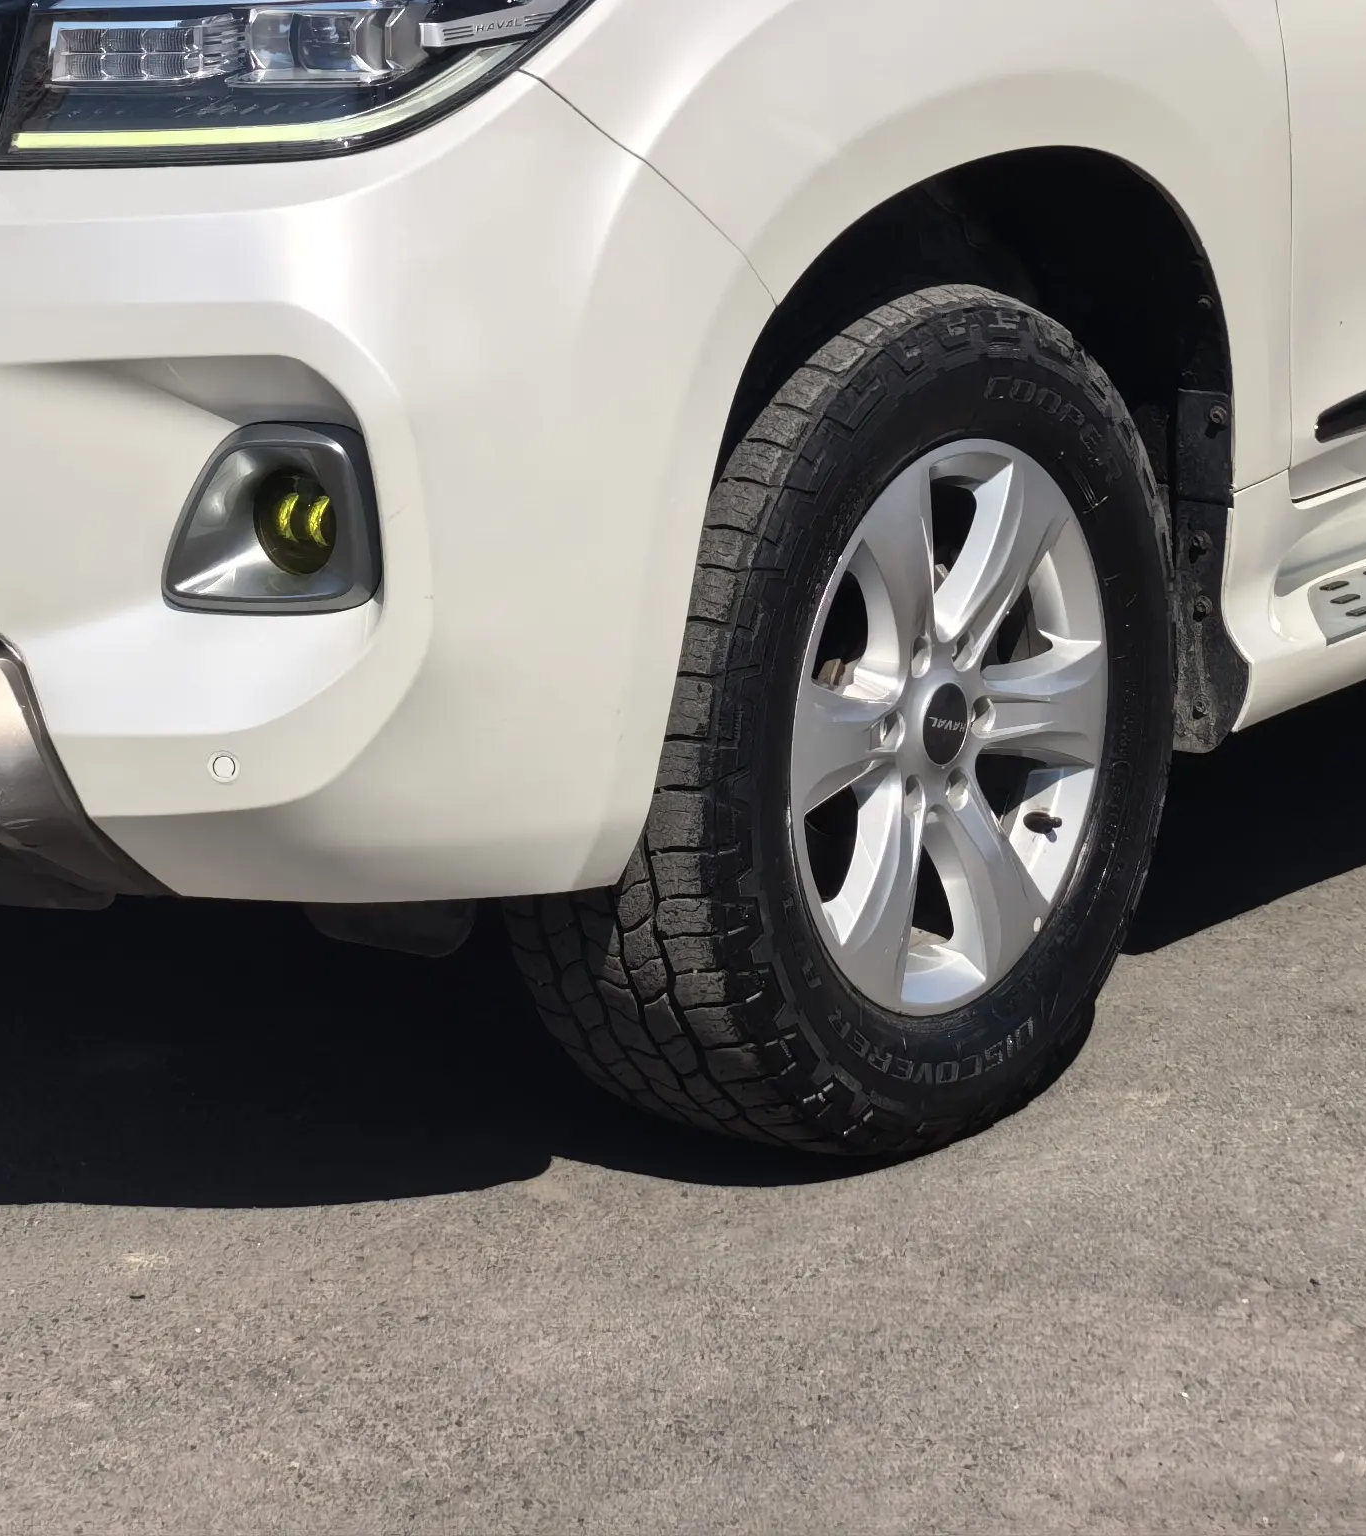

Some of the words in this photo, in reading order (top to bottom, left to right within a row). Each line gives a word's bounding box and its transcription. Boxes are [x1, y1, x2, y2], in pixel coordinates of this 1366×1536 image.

[475, 17, 523, 32] HAVAL
[983, 375, 1124, 488] COOPER
[928, 716, 967, 733] HAVAL
[826, 1012, 1035, 1086] DISCOVERER
